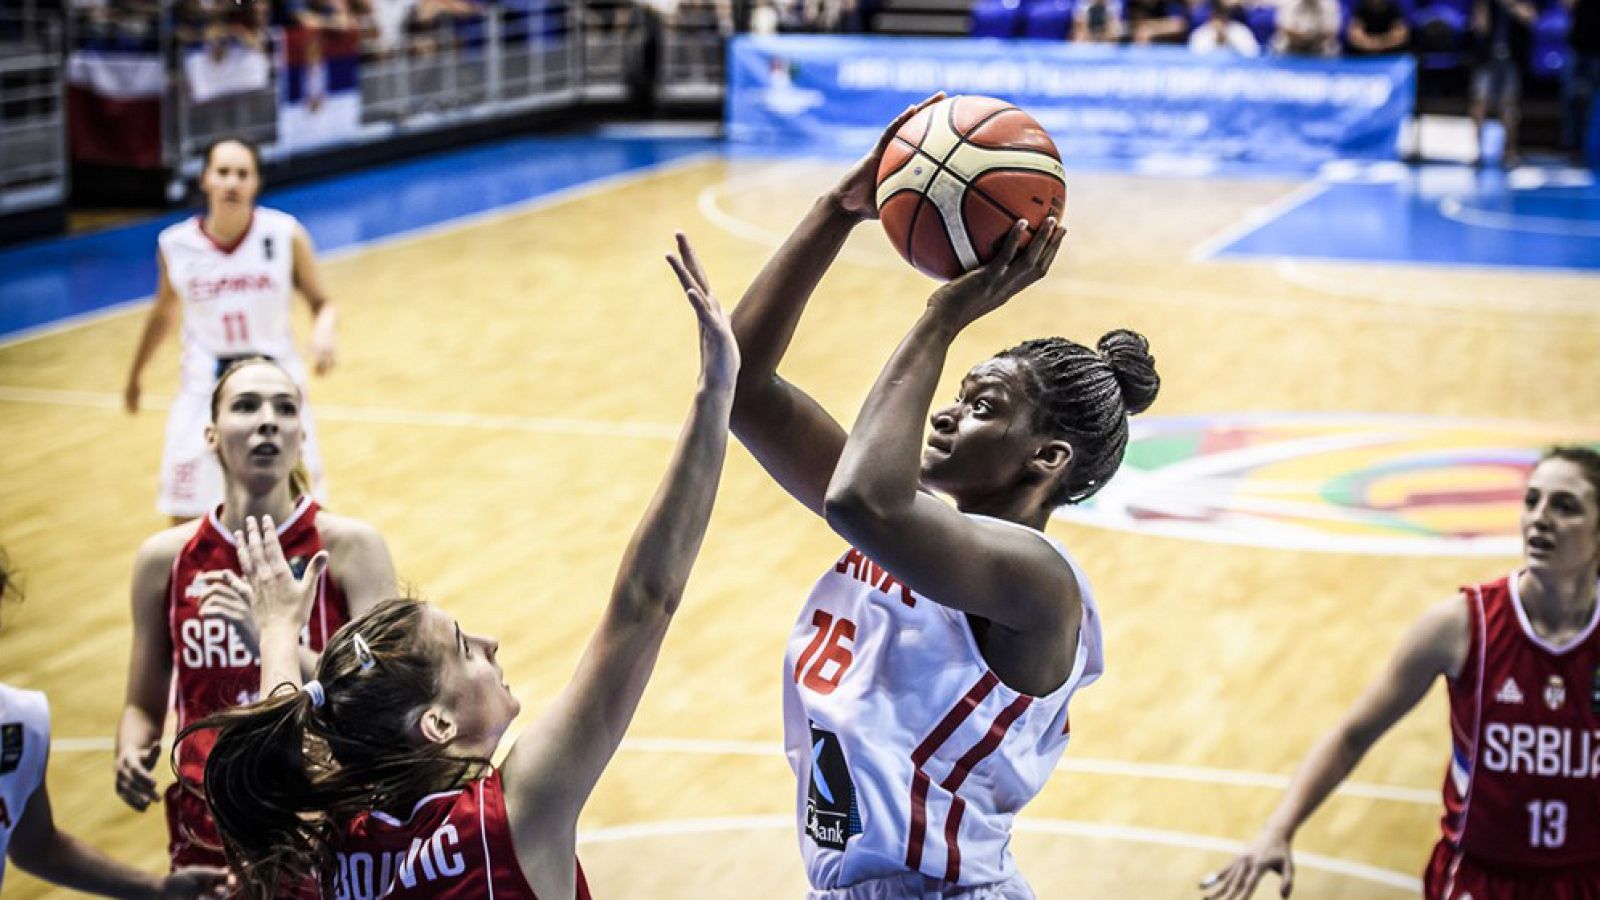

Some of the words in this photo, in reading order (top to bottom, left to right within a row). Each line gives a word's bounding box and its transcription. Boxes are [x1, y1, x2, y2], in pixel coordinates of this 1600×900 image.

[221, 310, 249, 342] 11
[794, 609, 857, 695] 16
[1527, 799, 1568, 848] 13
